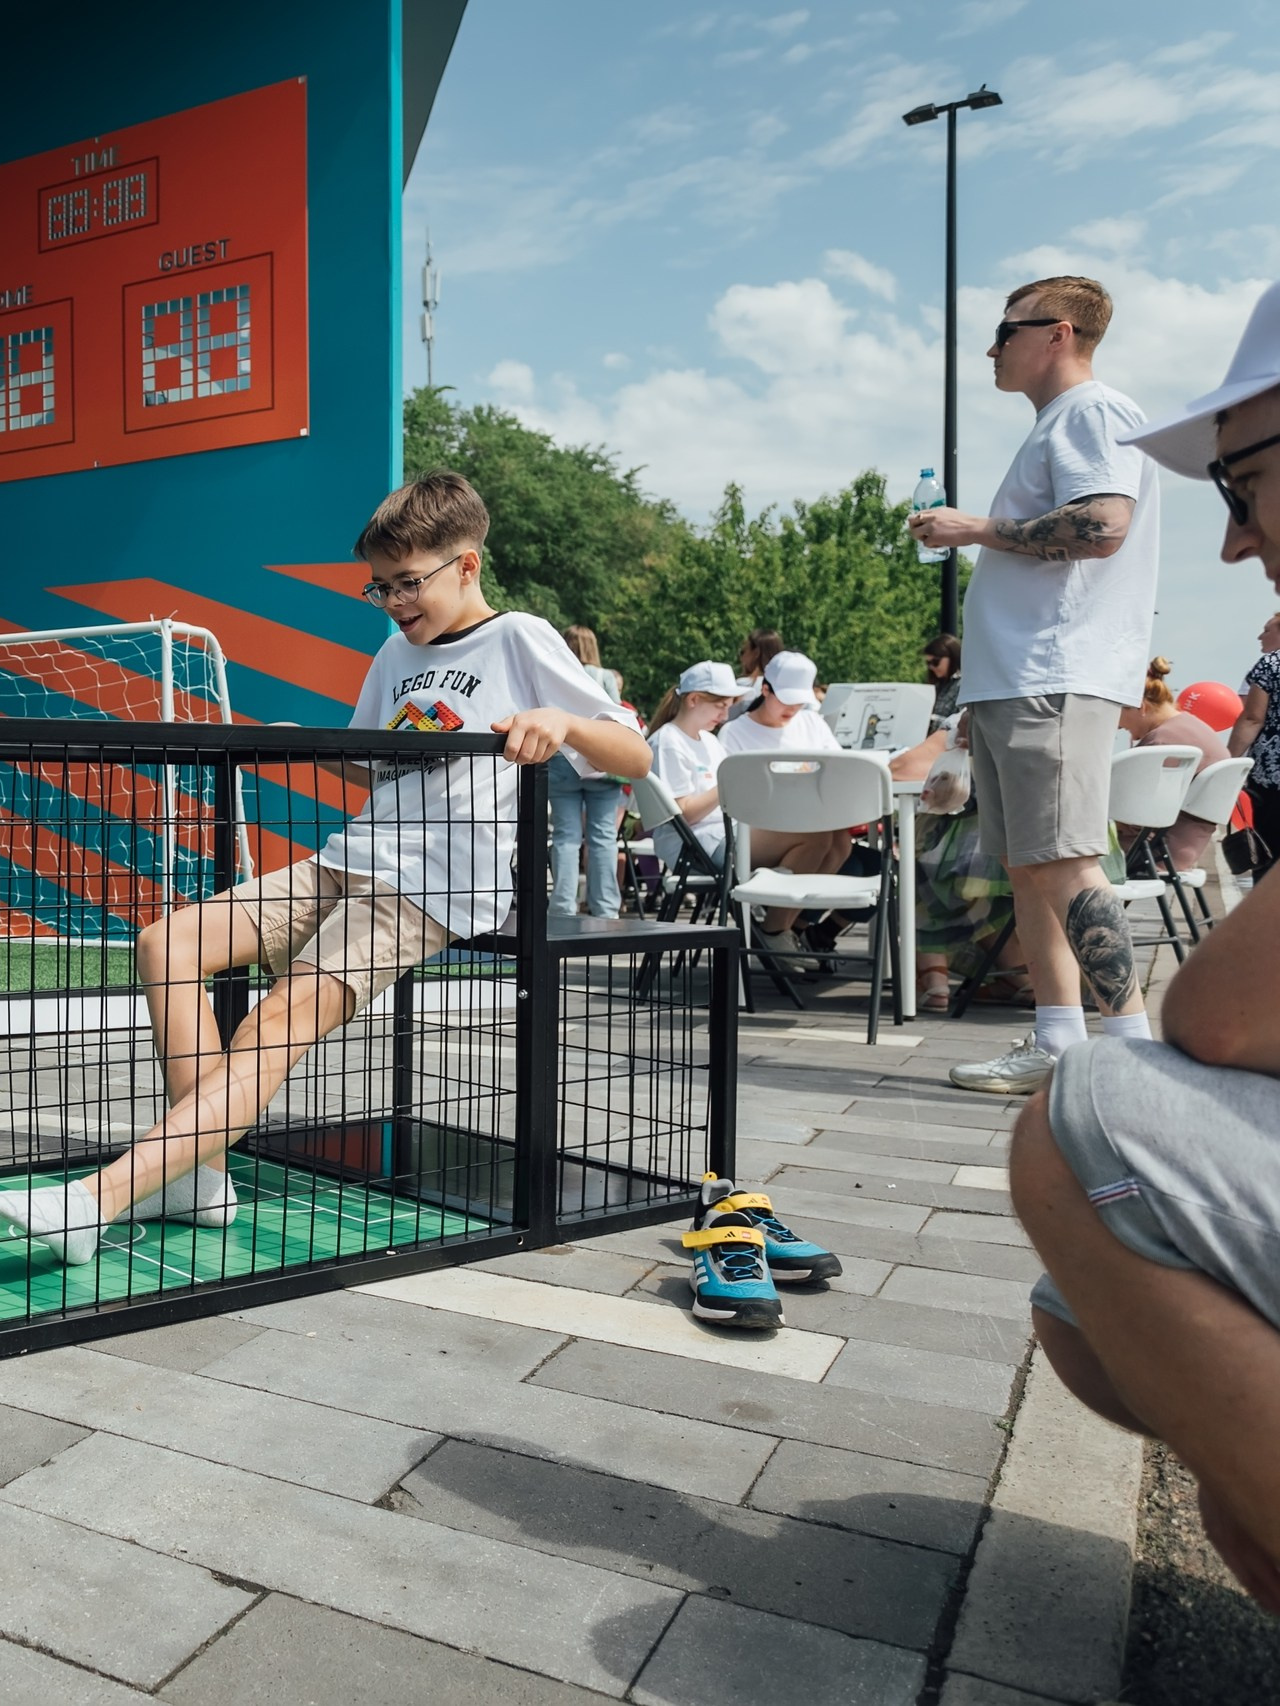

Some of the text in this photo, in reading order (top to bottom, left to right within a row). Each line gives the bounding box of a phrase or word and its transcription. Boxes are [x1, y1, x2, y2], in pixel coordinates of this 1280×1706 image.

[70, 145, 120, 176] TIME
[158, 238, 231, 272] GUEST
[393, 670, 482, 705] LEGO FUN
